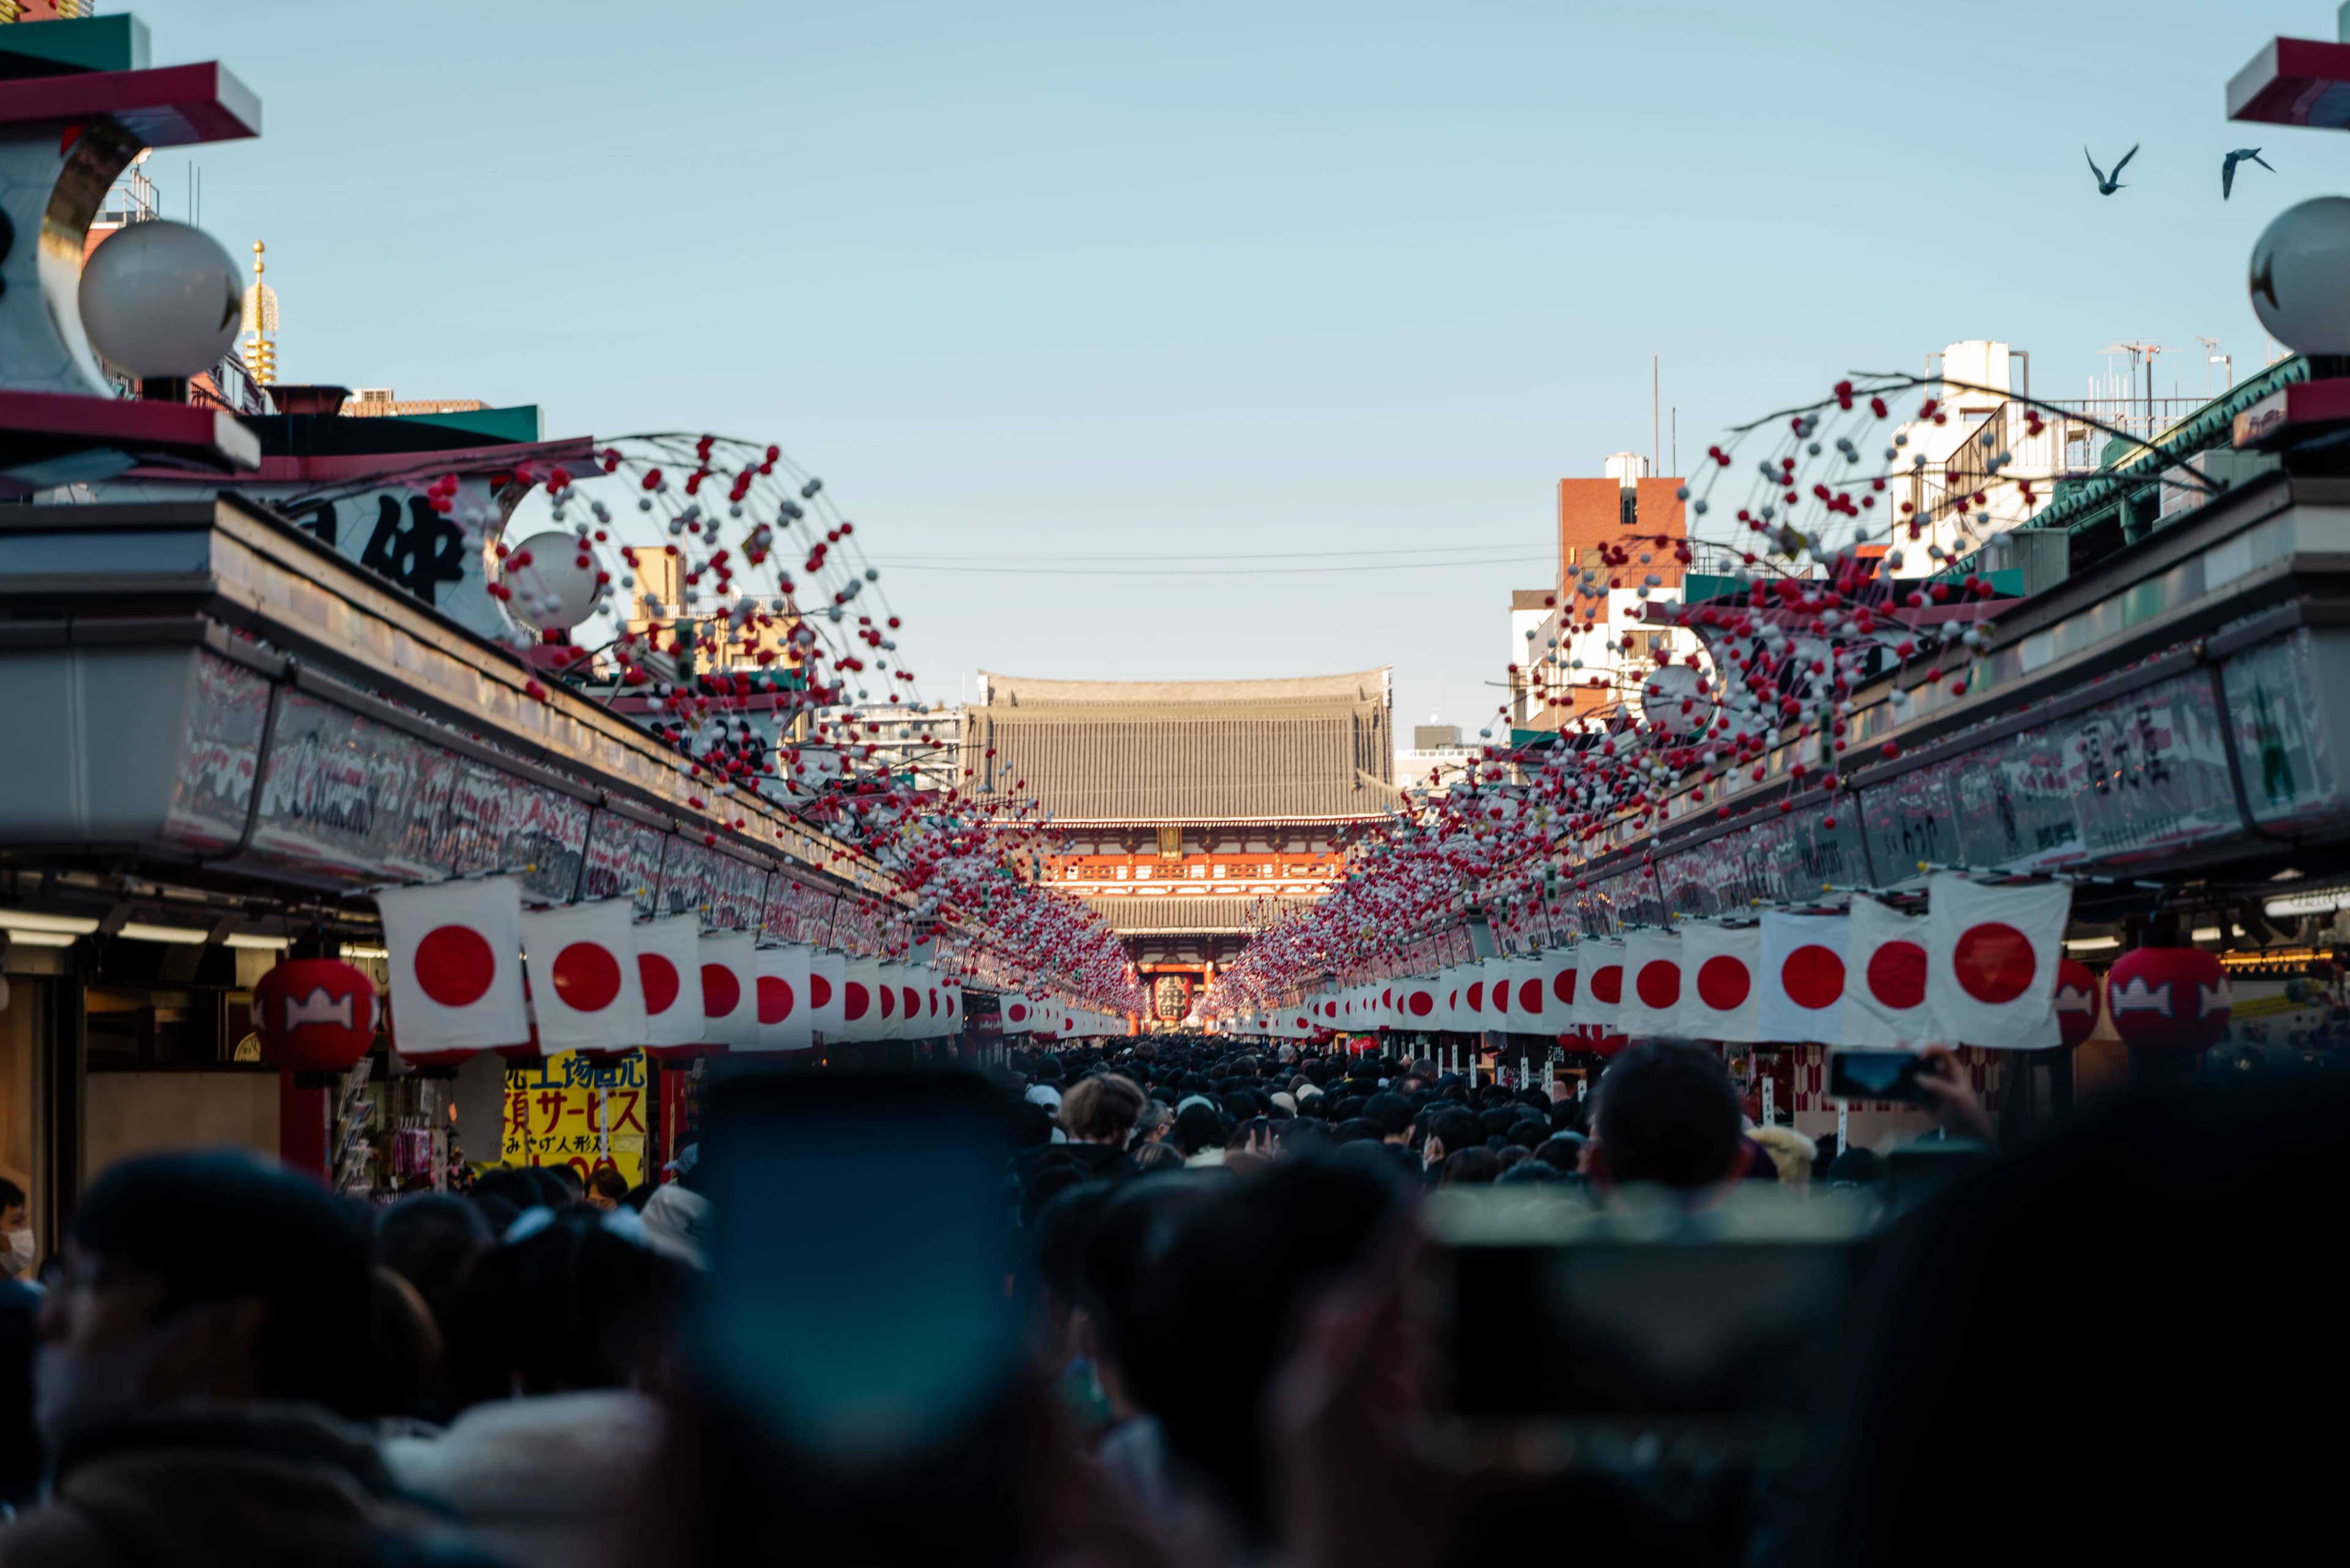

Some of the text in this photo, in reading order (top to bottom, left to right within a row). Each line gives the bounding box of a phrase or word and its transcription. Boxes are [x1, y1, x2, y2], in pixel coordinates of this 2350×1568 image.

[1158, 975, 1187, 1018] 小舟町
[502, 1135, 611, 1154] みやげ人形焼
